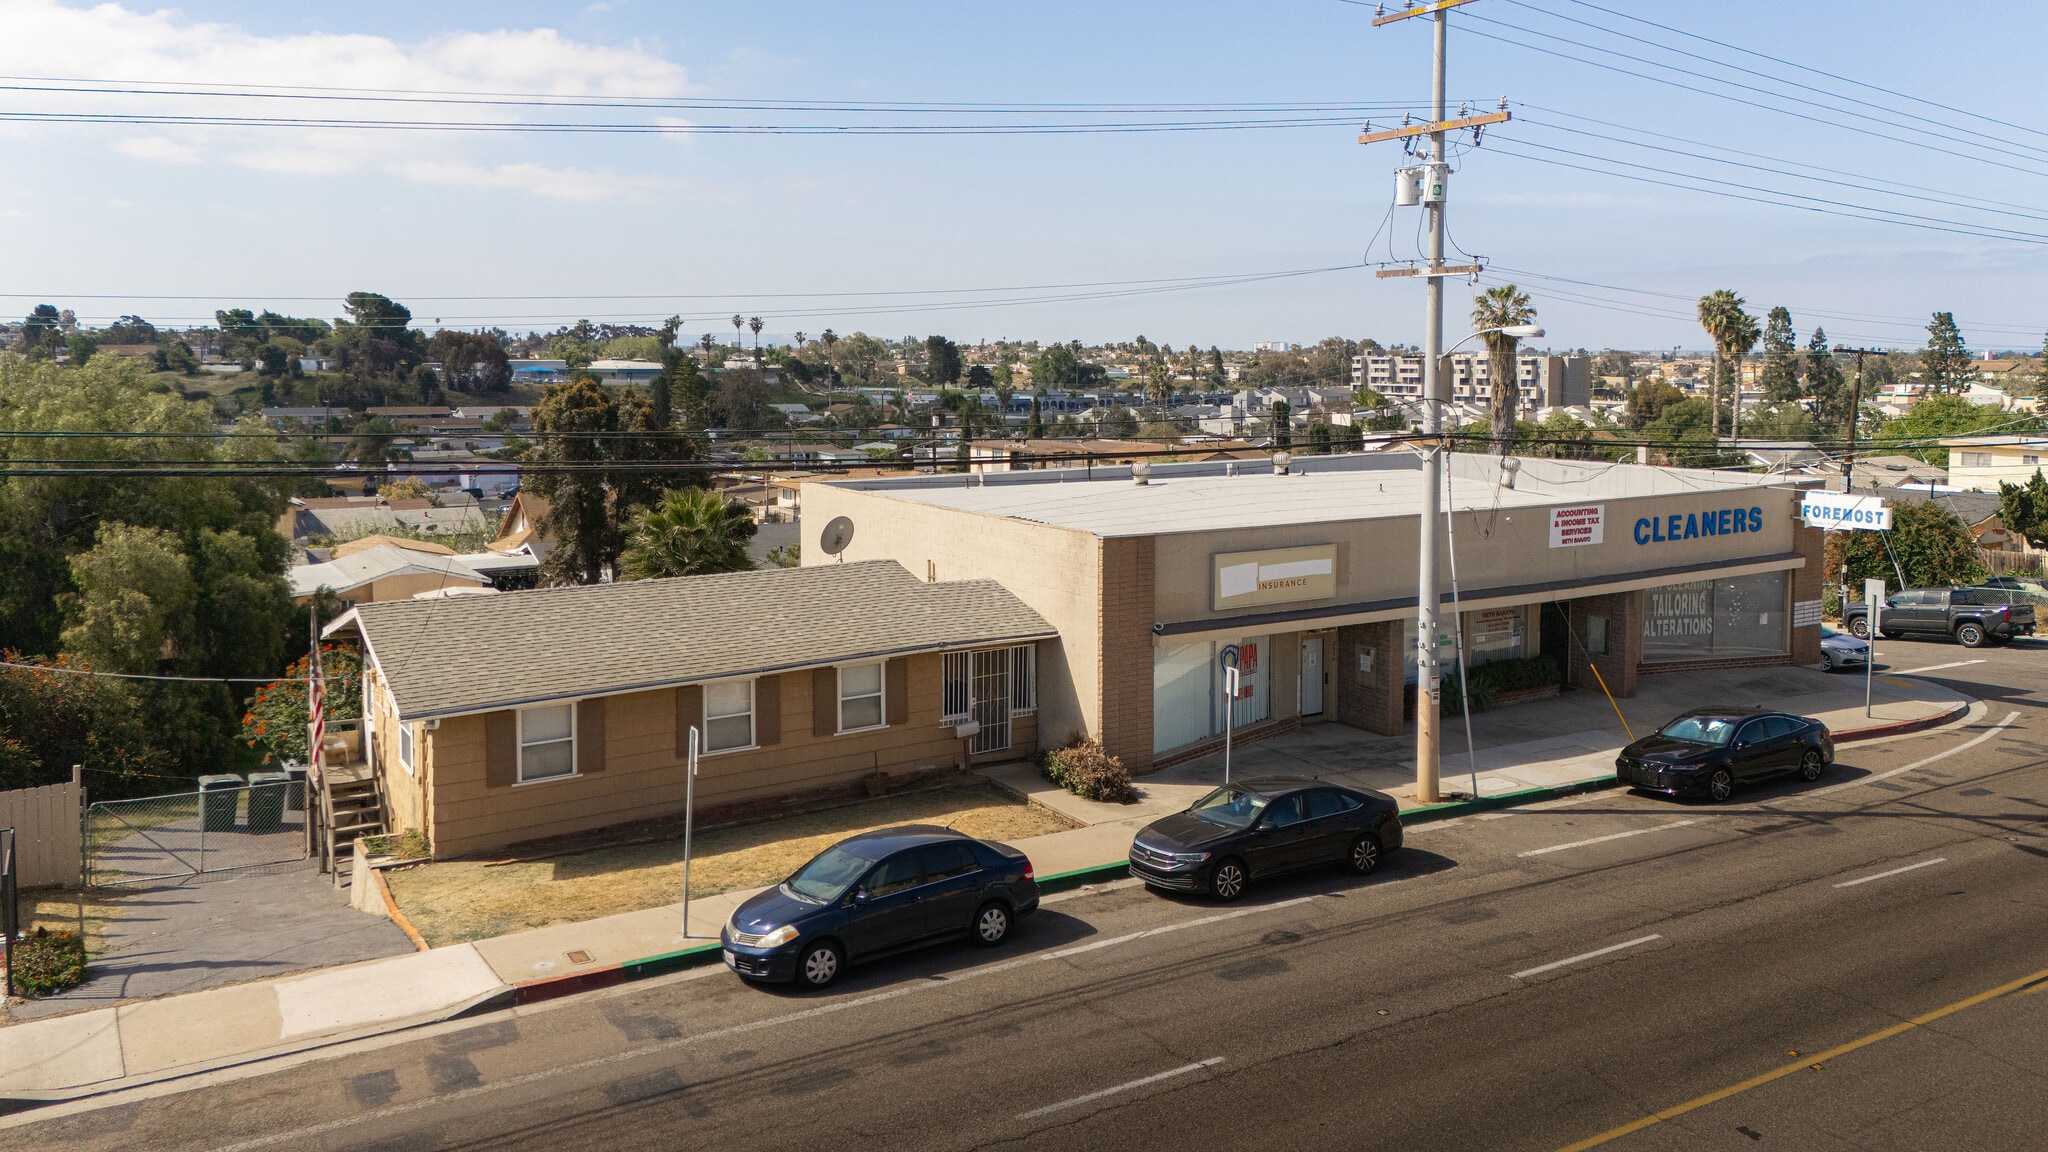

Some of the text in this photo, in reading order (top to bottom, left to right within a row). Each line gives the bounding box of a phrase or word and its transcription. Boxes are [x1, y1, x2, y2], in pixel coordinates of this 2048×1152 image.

[1556, 507, 1599, 518] ACCOUNTING
[1803, 505, 1884, 524] FOREMOST
[1554, 517, 1600, 528] & INCOME TAX
[1561, 527, 1592, 536] SERVICES
[1633, 506, 1763, 546] CLEANERS
[1258, 578, 1307, 590] INSURANCE
[1652, 592, 1706, 616] TAILORING
[1643, 617, 1713, 636] ALTERATIONS
[1239, 643, 1258, 671] PAPA
